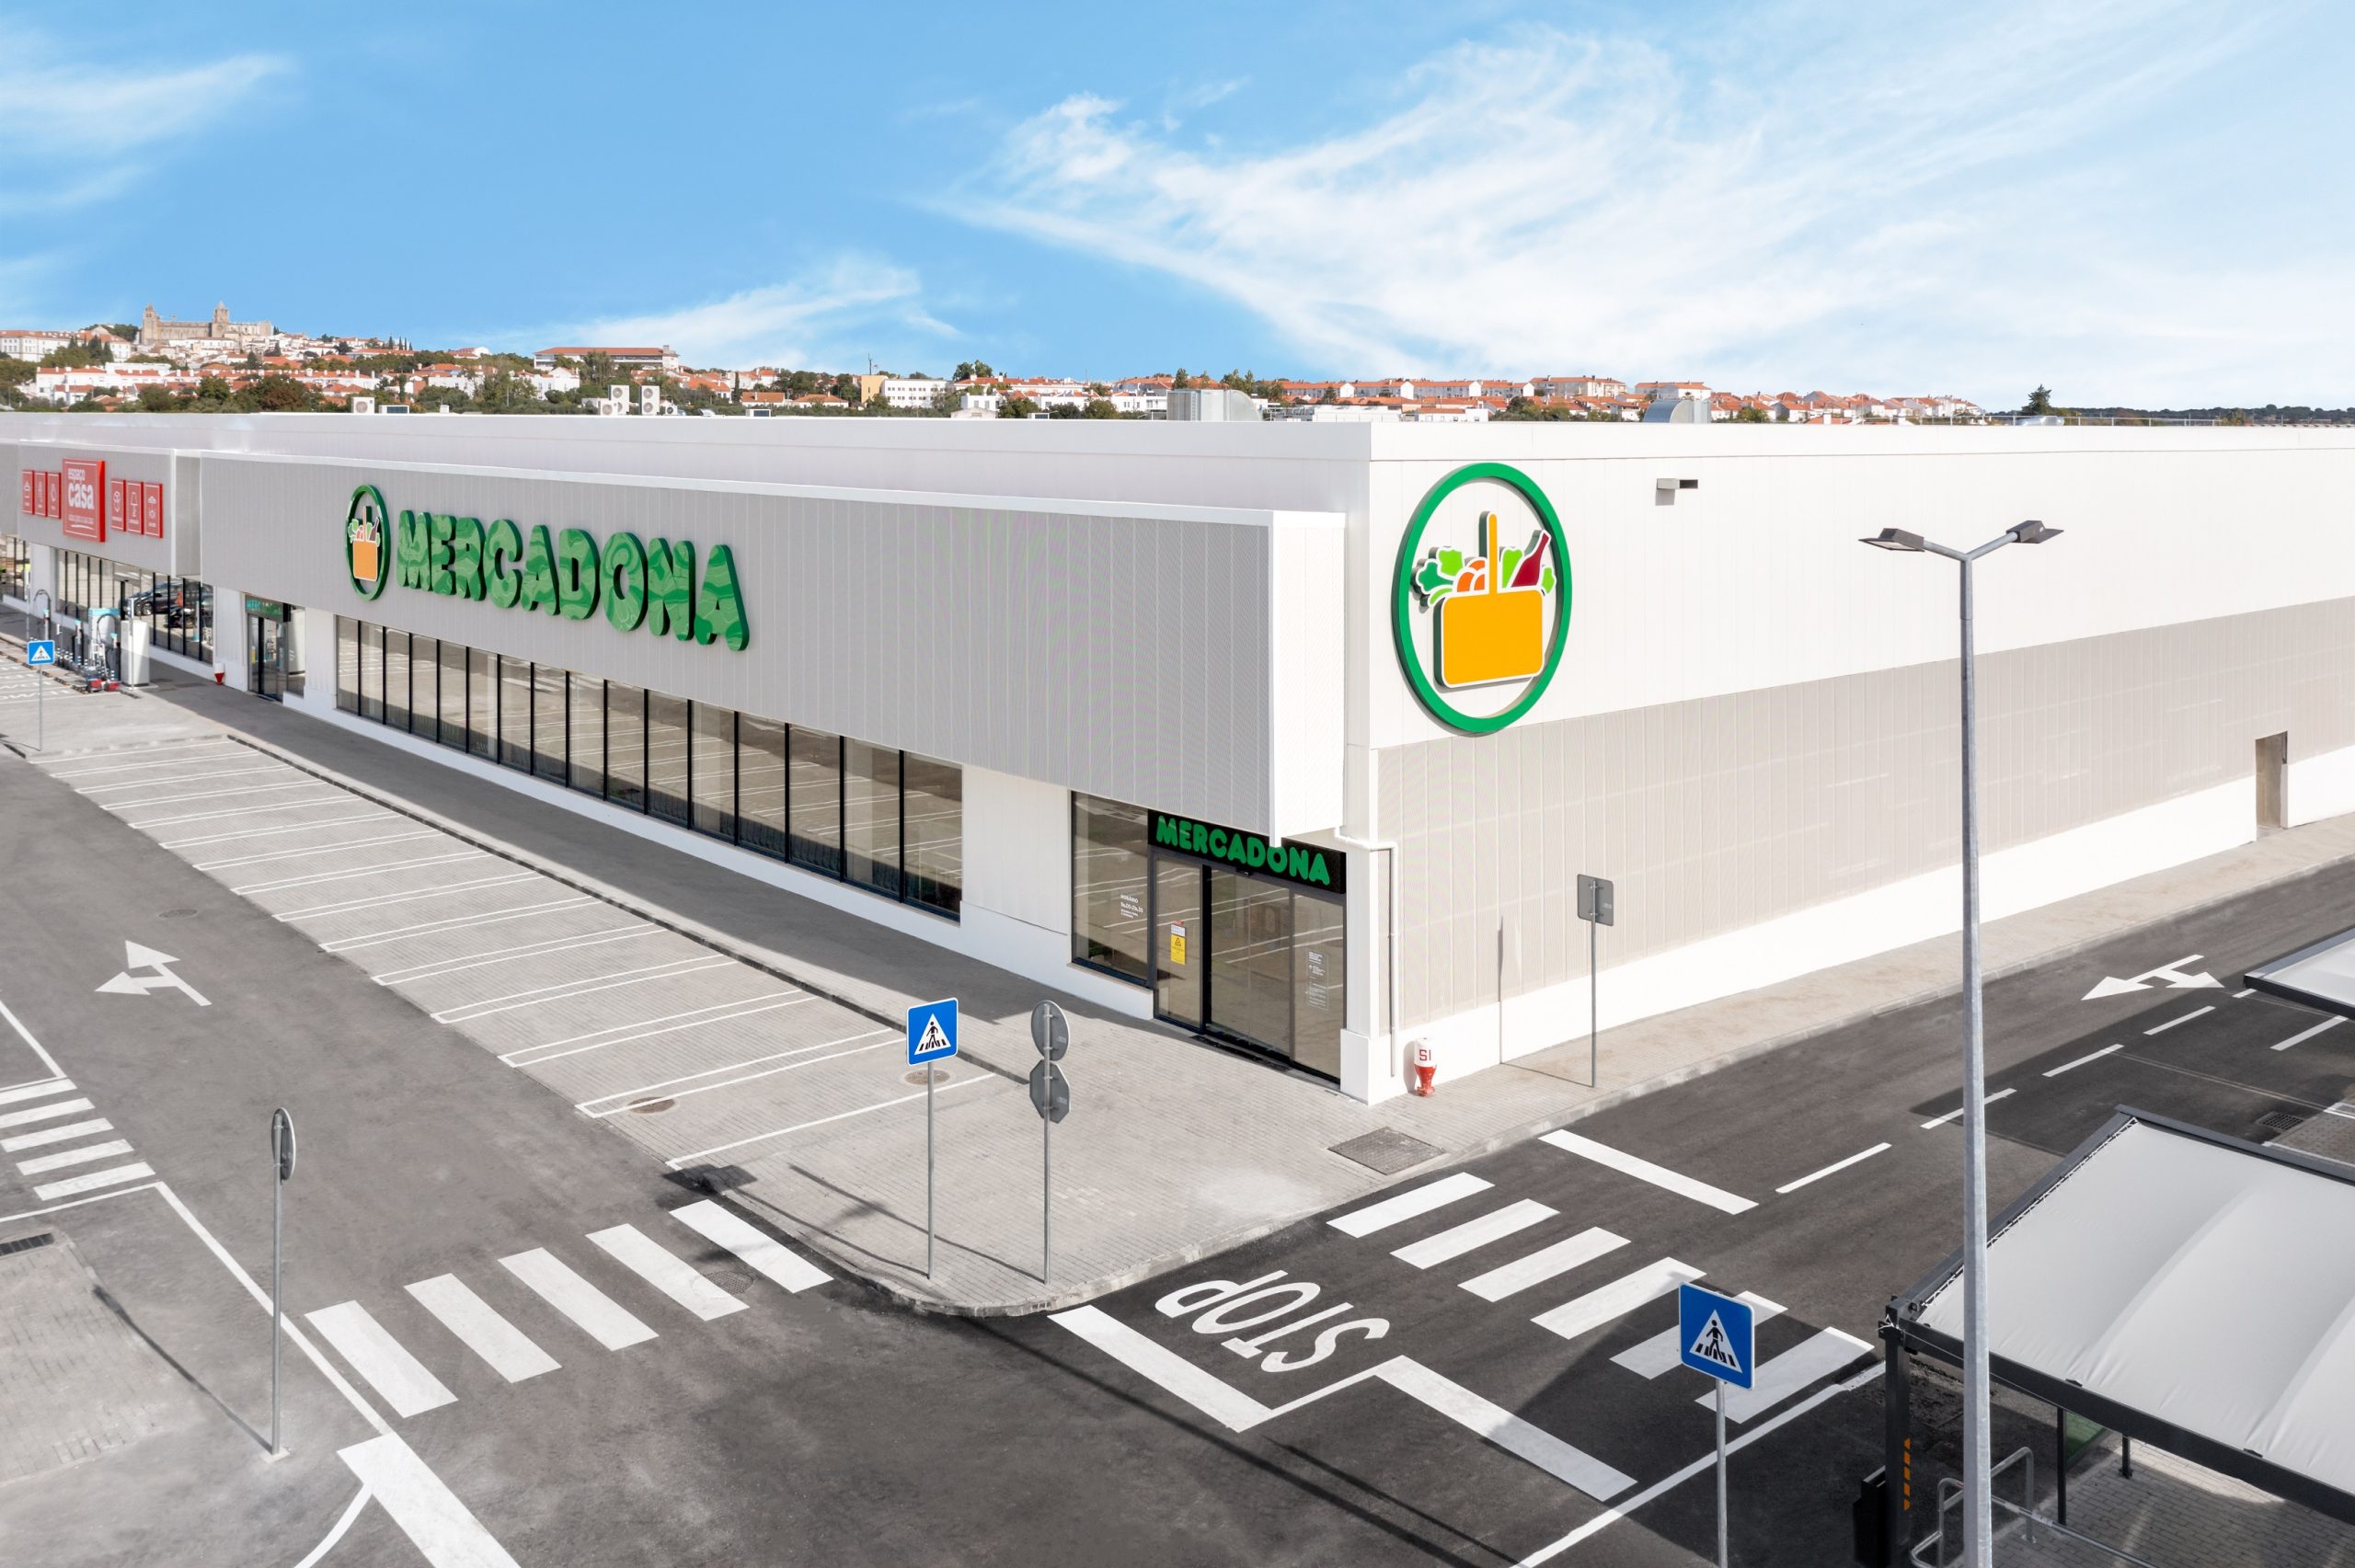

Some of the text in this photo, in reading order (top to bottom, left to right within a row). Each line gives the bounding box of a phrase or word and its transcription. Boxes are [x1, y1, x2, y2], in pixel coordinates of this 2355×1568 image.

[68, 483, 95, 509] casa
[396, 509, 750, 652] MERCADONA
[1155, 815, 1330, 886] MERCADONA
[1419, 1048, 1431, 1061] SI
[1155, 1269, 1390, 1373] STOP
